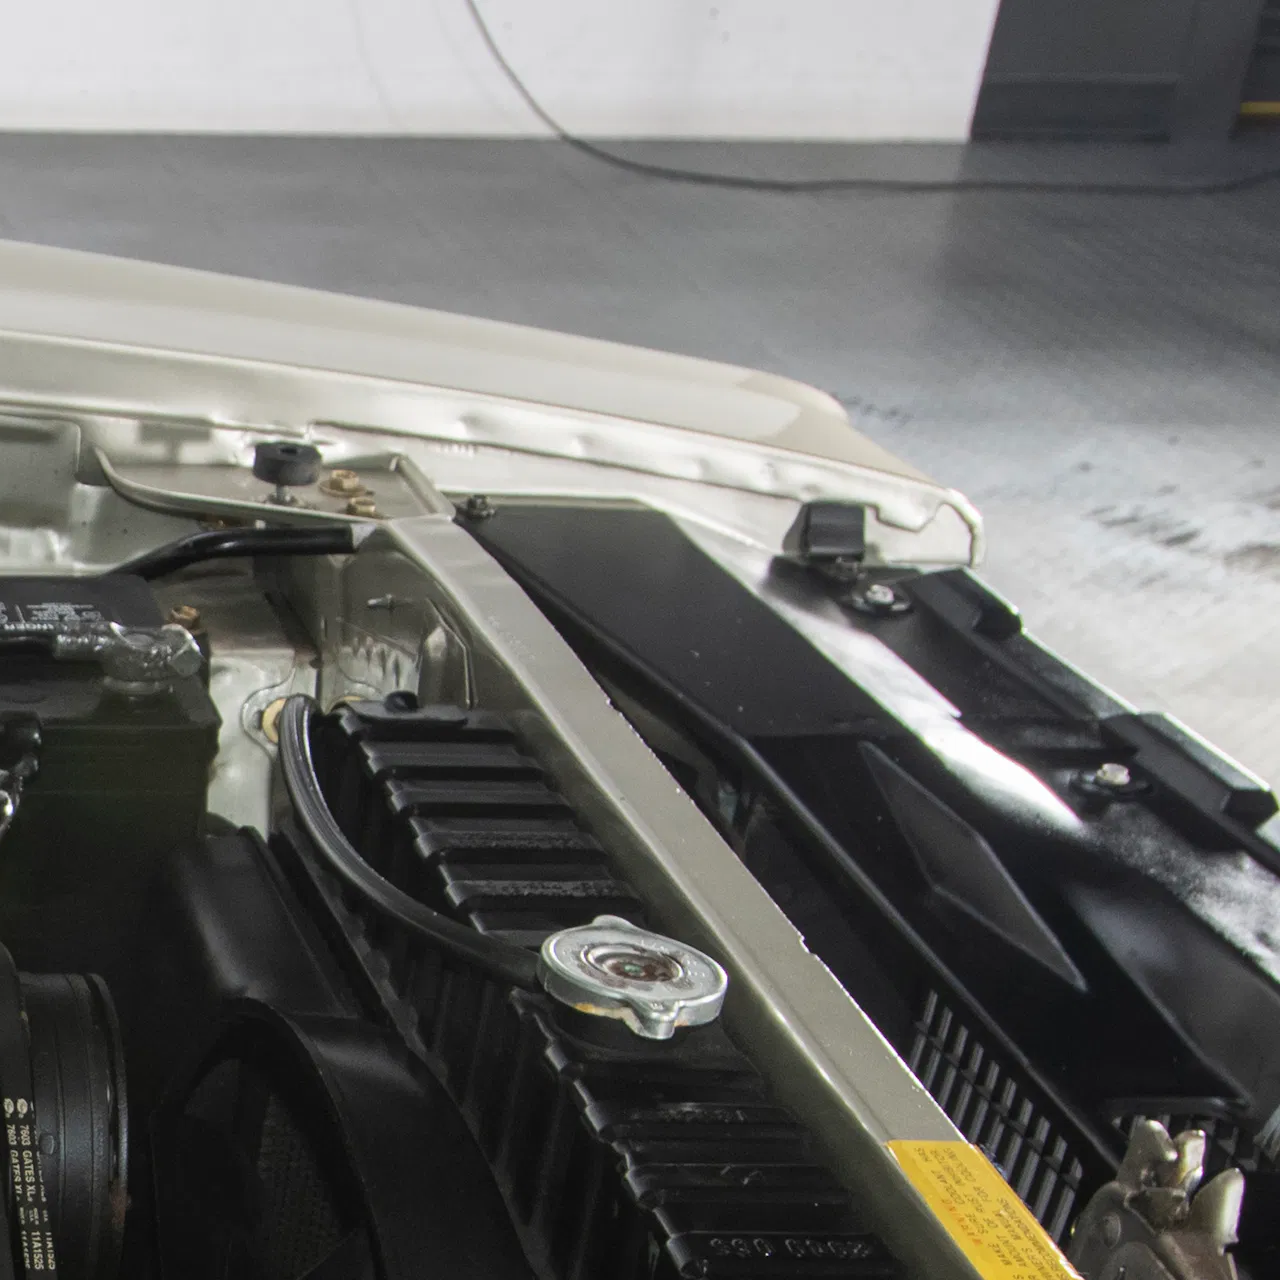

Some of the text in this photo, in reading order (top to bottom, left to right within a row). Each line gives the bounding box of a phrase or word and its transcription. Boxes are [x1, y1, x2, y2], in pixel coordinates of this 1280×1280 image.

[18, 1124, 30, 1145] 7603
[20, 1149, 36, 1183] GATES
[29, 1230, 45, 1270] 11A1525
